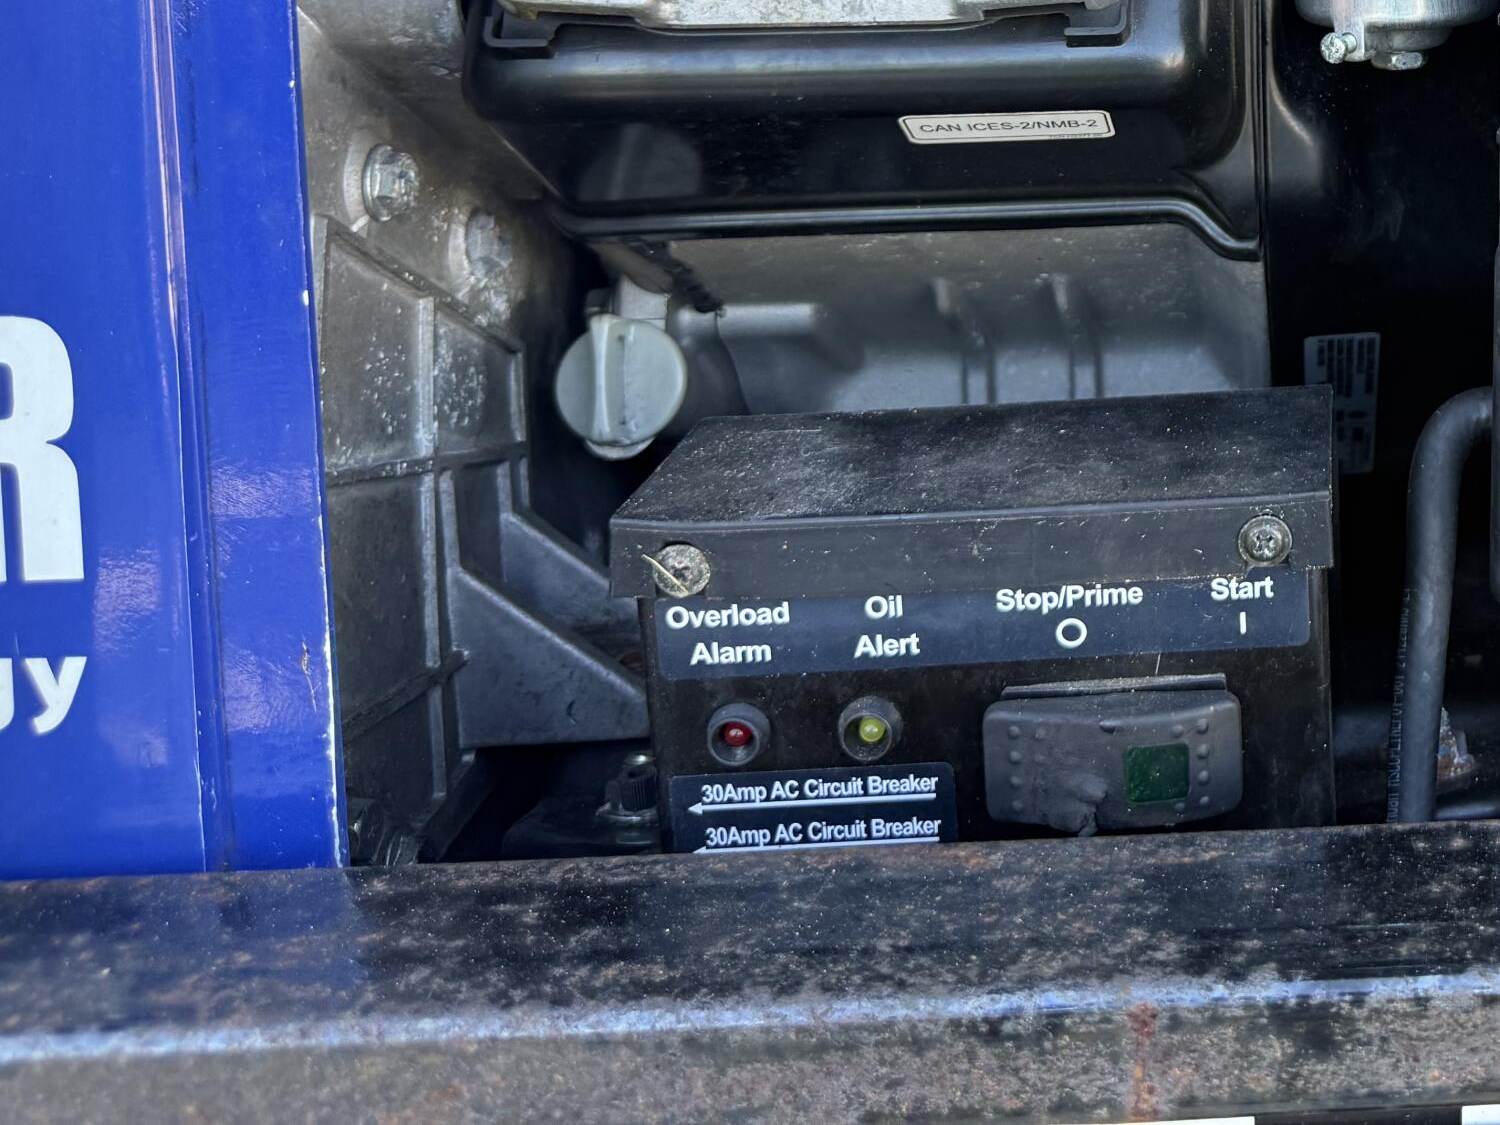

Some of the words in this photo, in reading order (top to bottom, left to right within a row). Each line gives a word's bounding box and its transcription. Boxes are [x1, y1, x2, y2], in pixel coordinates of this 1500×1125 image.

[920, 122, 962, 133] CAN
[967, 118, 1099, 133] ICES-2/NMB-2
[996, 583, 1144, 615] Stop/Prime
[1210, 576, 1275, 602] Start
[665, 602, 790, 629] Overload
[864, 595, 904, 620] Oil
[690, 641, 772, 666] Alarm
[853, 633, 921, 659] Alert
[701, 783, 768, 804] 30Amp
[771, 779, 800, 799] AC
[804, 777, 864, 797] Circuit
[868, 773, 939, 794] Breaker
[706, 826, 771, 847] 30Amp
[774, 822, 803, 842] AC
[807, 820, 867, 841] Circuit
[871, 816, 942, 837] Breaker
